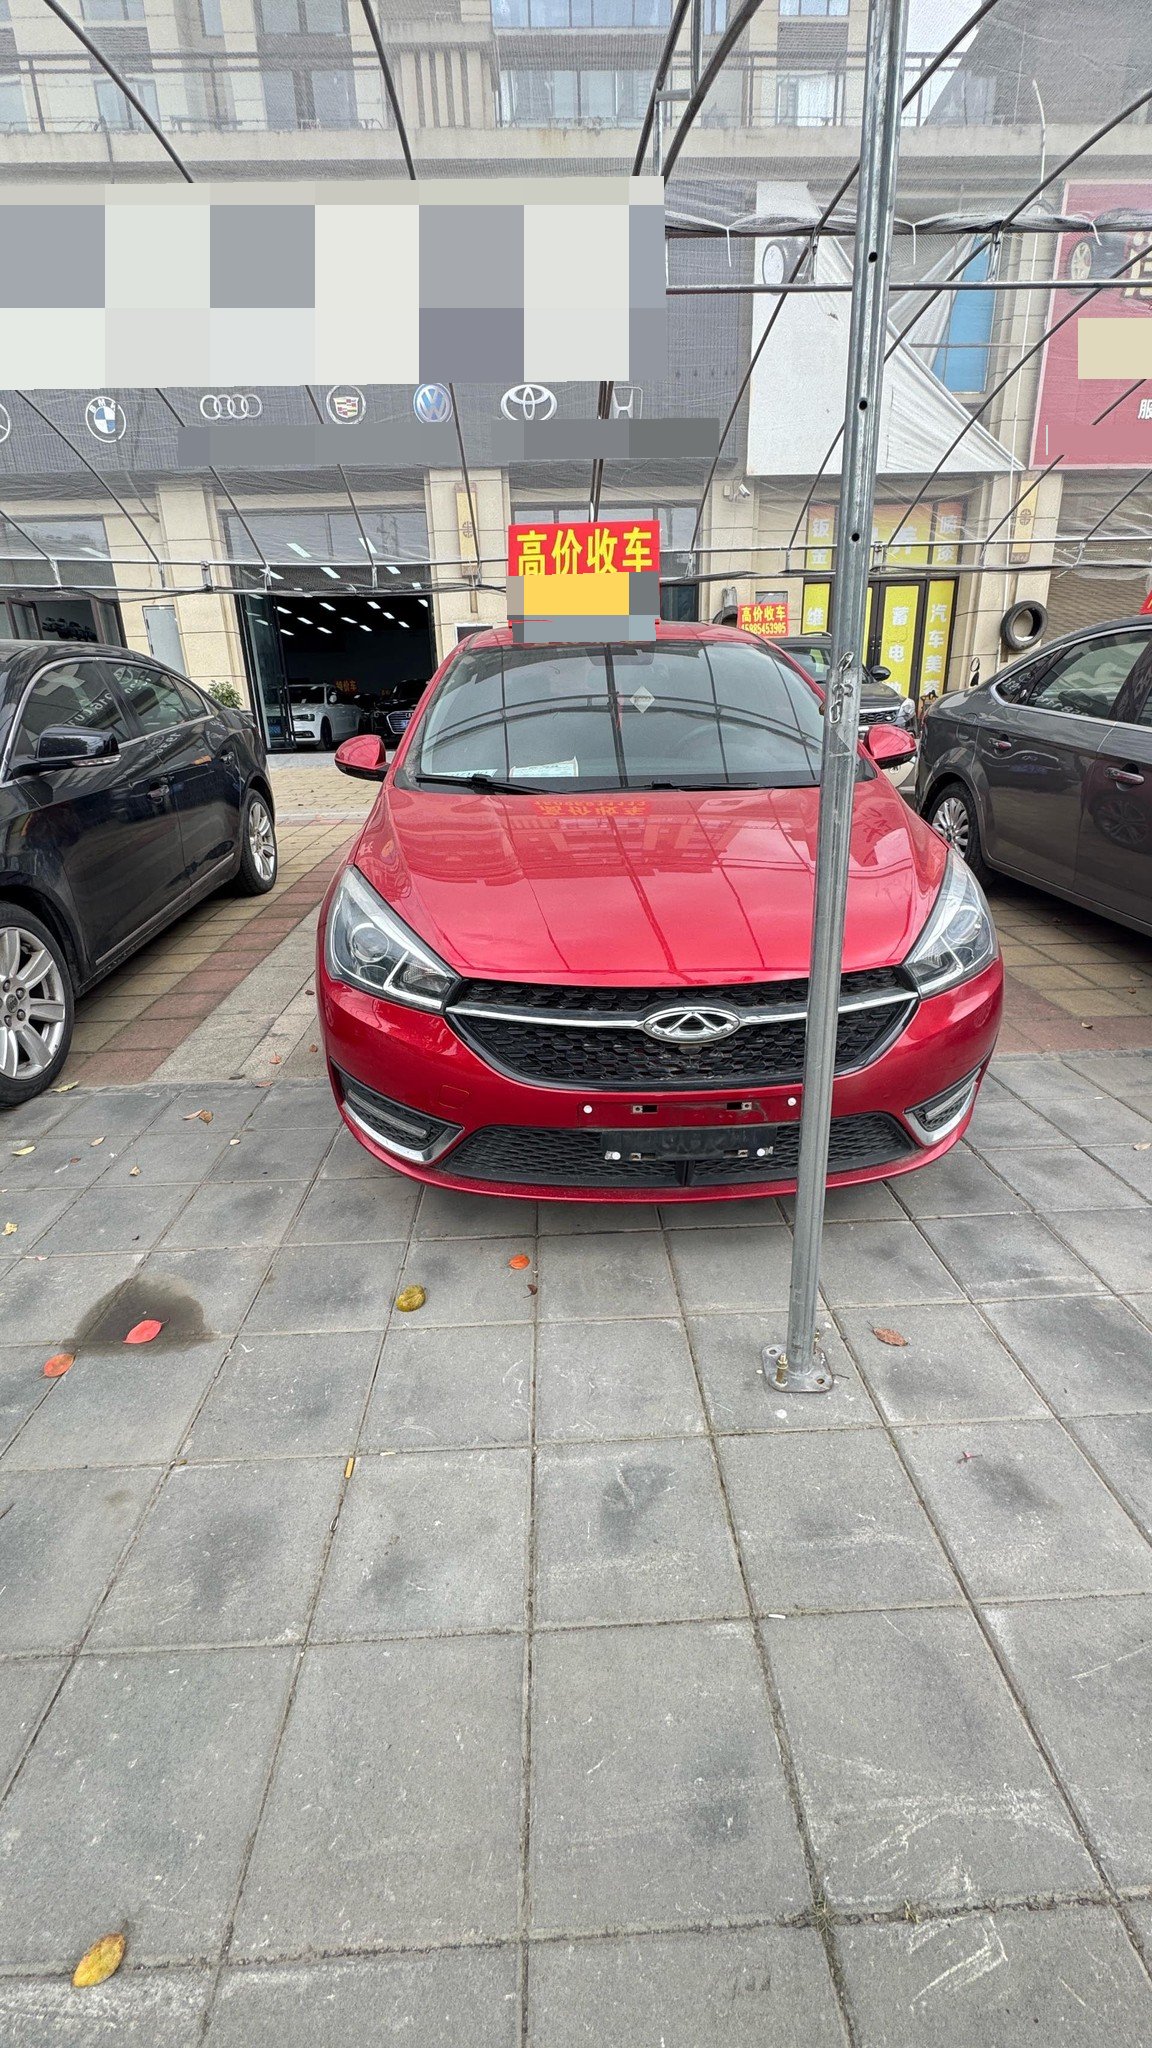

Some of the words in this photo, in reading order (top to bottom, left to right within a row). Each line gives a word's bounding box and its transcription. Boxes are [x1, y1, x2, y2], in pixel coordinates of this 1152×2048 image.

[516, 526, 653, 576] 高价收车
[741, 604, 787, 623] 高价收车
